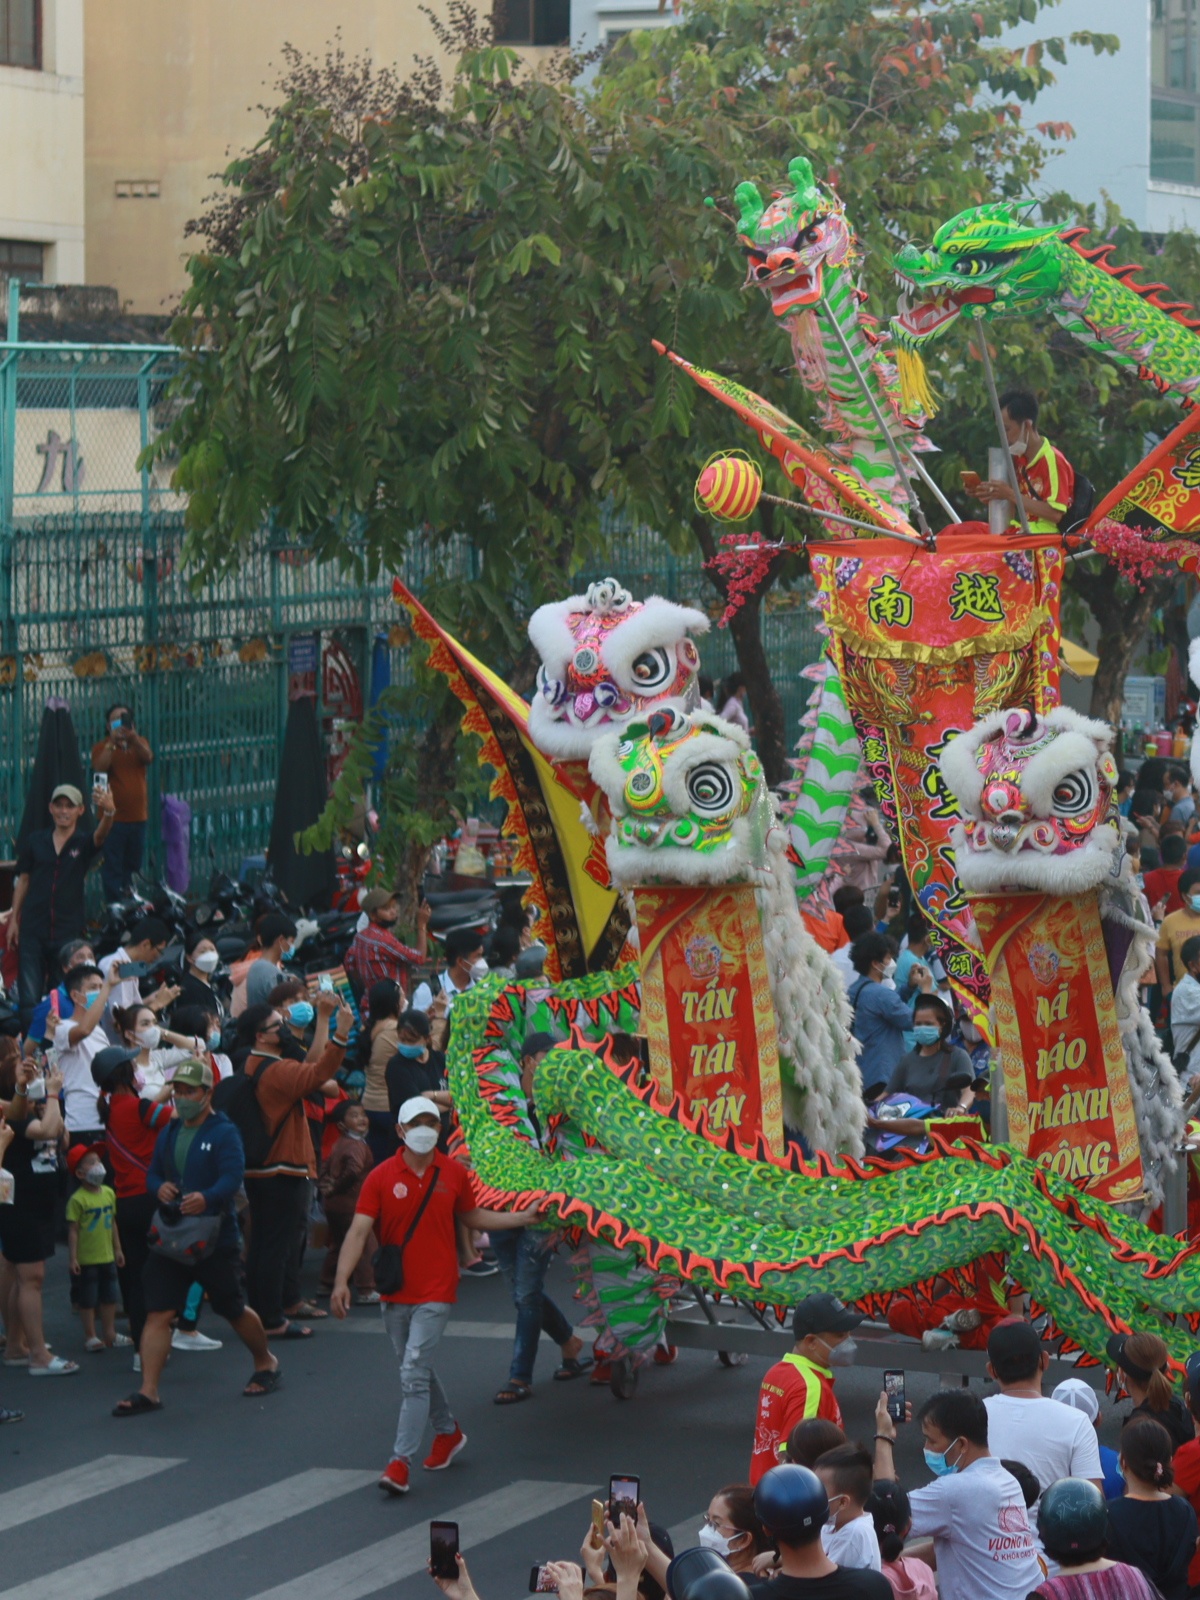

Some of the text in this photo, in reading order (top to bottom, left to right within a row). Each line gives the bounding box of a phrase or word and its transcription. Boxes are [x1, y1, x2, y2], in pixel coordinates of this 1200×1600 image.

[682, 976, 738, 1024] TẤN
[690, 1033, 737, 1078] TÀI
[1036, 1033, 1088, 1081] ĐÁO
[1027, 1084, 1110, 1137] THÀNH
[1035, 1139, 1112, 1181] CÔNG
